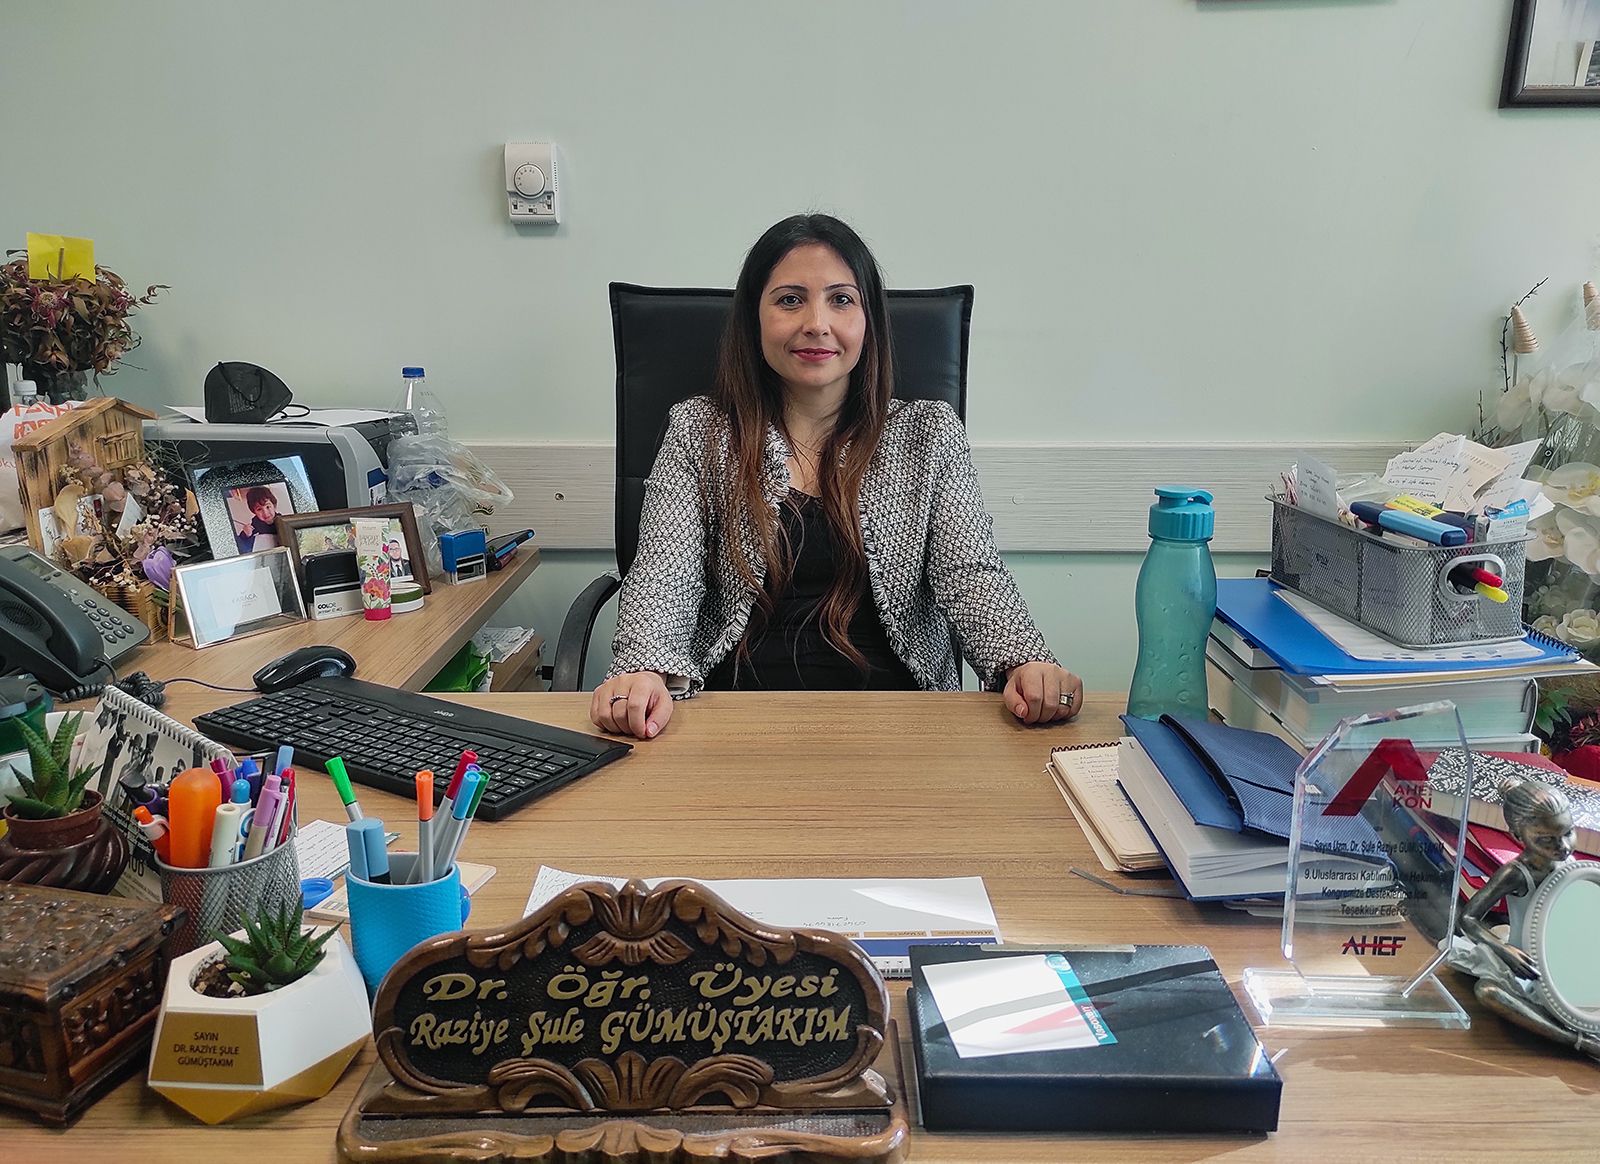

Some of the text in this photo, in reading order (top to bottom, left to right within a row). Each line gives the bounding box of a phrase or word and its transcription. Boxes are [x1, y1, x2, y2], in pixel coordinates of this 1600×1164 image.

[1392, 797, 1432, 809] KON
[1341, 935, 1407, 956] AHEF
[422, 962, 840, 1008] Dr. Öğr. Üyesi
[194, 1031, 219, 1041] SAYIN
[410, 1001, 851, 1058] Raziye Şule GÜMÜŞTAKIM
[173, 1043, 240, 1056] DR. RAZİYE ŞULE
[177, 1055, 234, 1068] GÜMÜŞTAKIM
